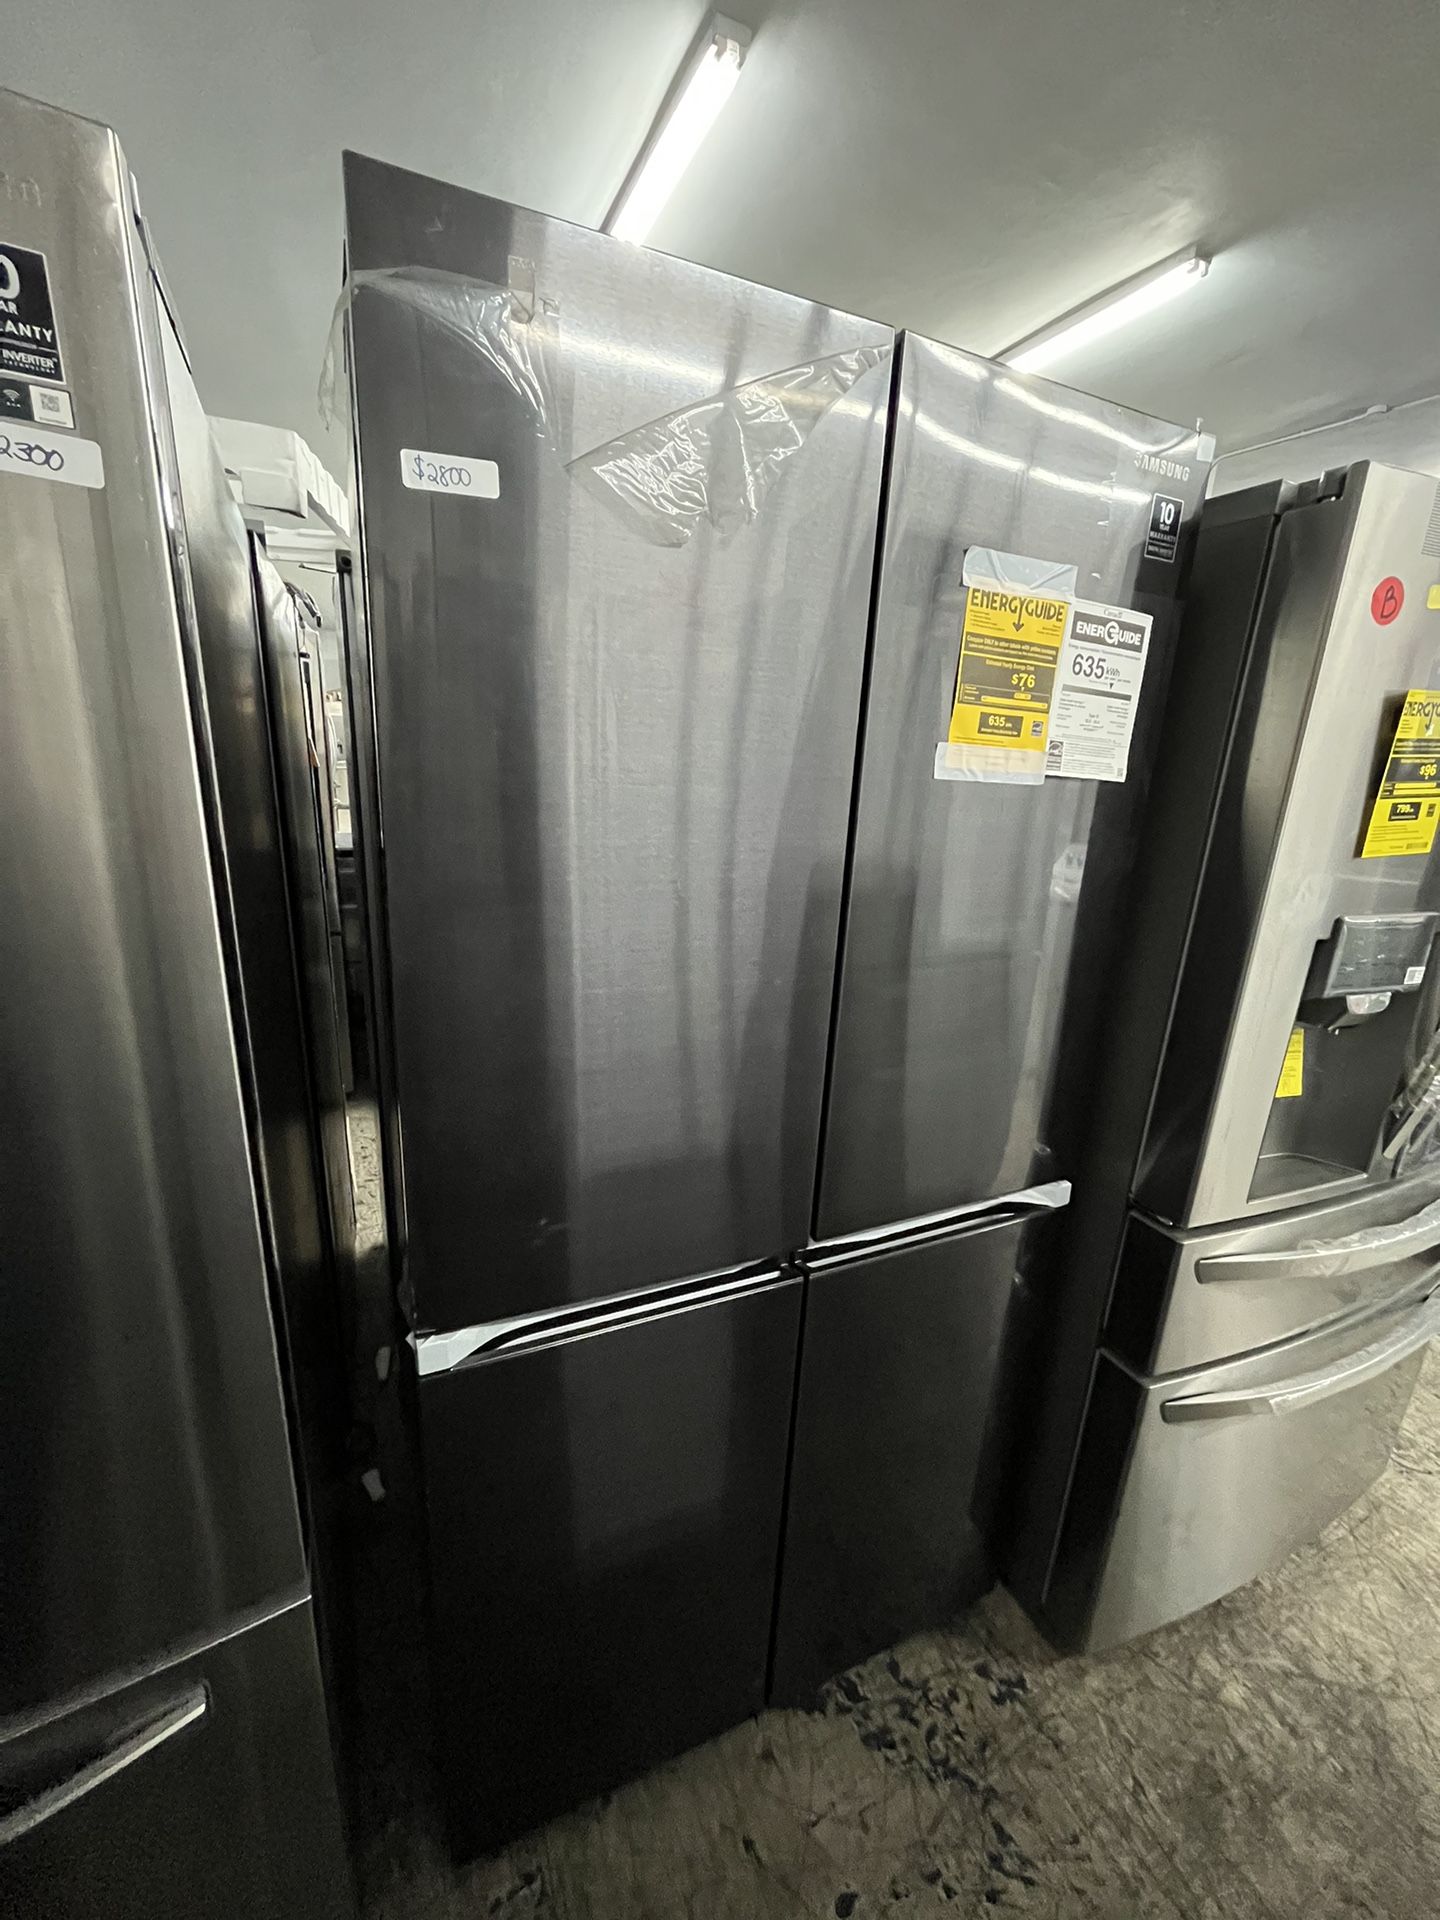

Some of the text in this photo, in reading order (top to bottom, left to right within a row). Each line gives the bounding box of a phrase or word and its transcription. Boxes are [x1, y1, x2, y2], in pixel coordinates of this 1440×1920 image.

[0, 319, 53, 343] ANTY
[2, 349, 55, 369] INVERTER
[412, 454, 472, 487] $2800
[1133, 451, 1190, 481] SAMSUNG
[1161, 501, 1175, 525] 10
[971, 588, 1065, 623] ENERGYGUIDE
[1381, 585, 1396, 619] B
[1076, 621, 1142, 646] ENERGUIDE
[1072, 653, 1121, 679] 635 kWh
[1011, 673, 1036, 688] $76
[988, 715, 1006, 727] 635
